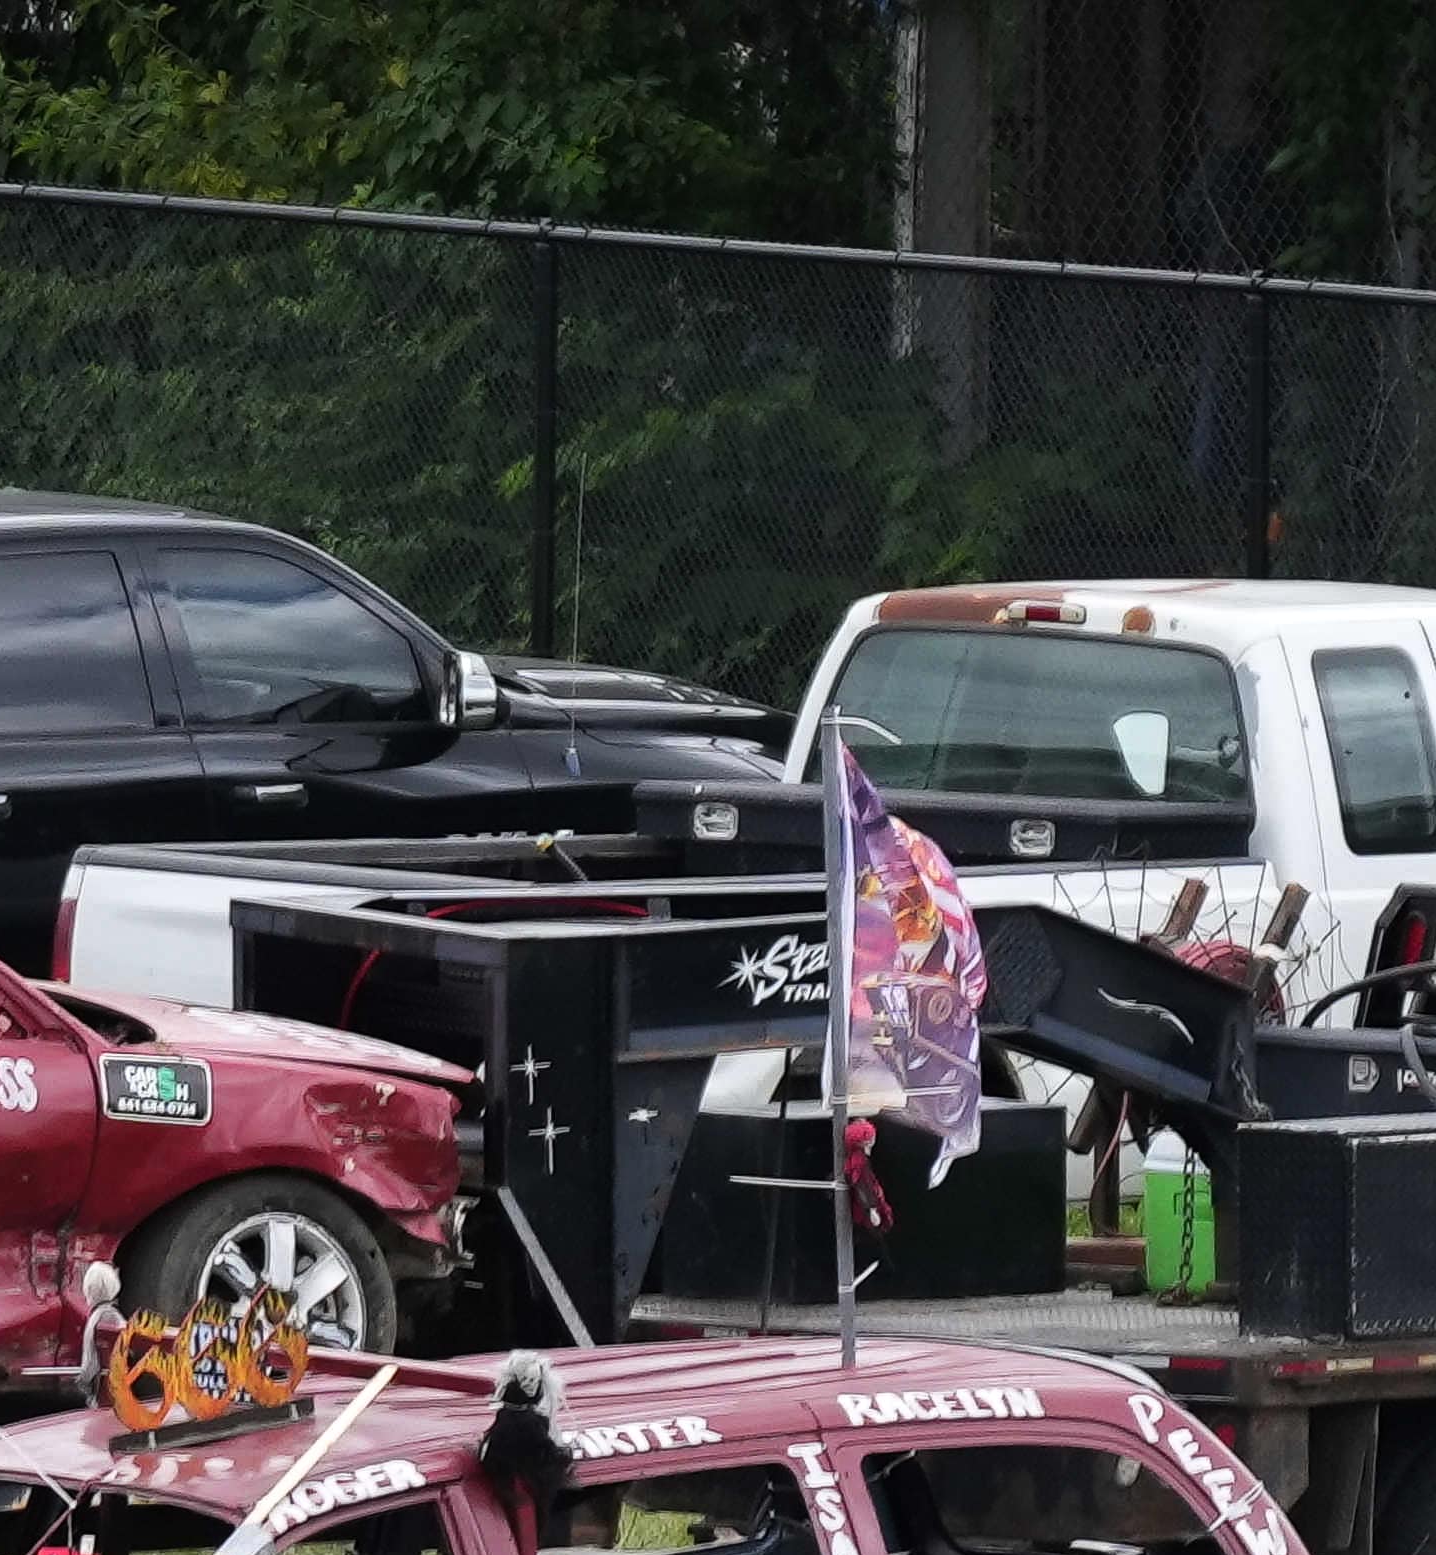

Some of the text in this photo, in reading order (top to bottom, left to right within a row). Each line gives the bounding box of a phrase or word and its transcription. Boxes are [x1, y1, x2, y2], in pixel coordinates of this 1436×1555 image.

[753, 933, 830, 1006] Sta
[782, 982, 831, 1003] TRA
[109, 1284, 309, 1432] 666
[836, 1387, 1046, 1428] RACELYN
[565, 1415, 723, 1460] ARTER
